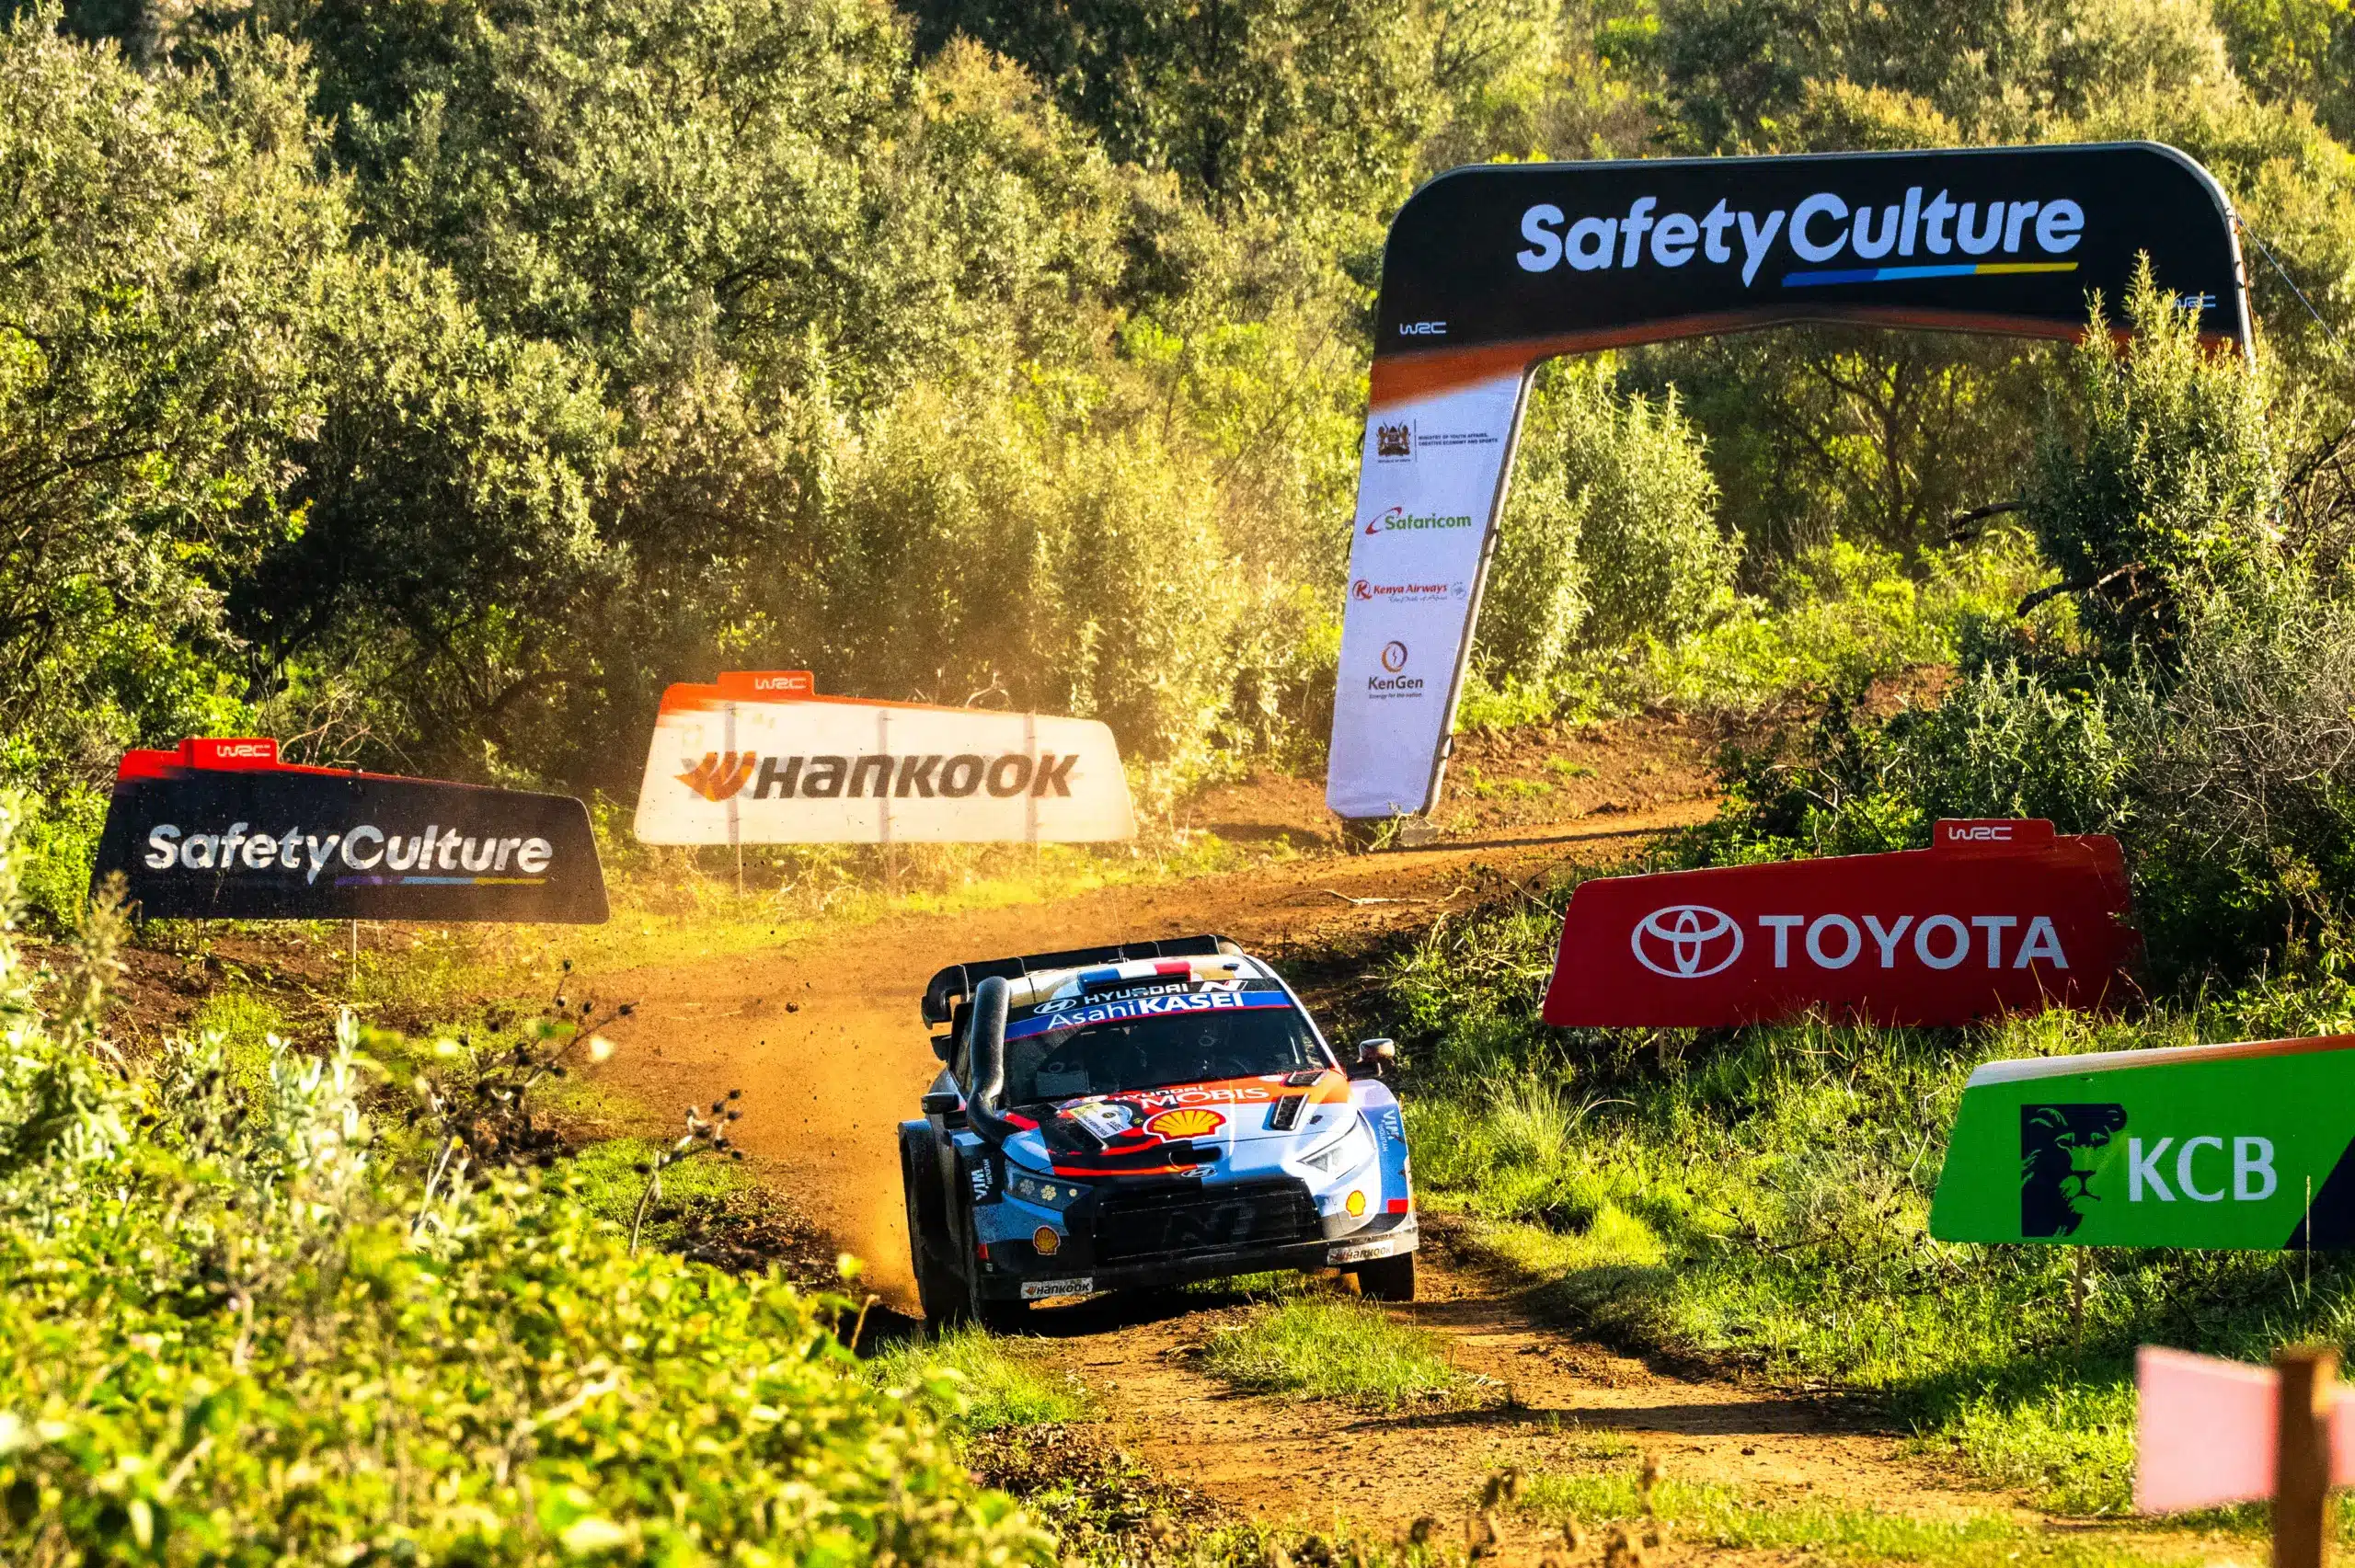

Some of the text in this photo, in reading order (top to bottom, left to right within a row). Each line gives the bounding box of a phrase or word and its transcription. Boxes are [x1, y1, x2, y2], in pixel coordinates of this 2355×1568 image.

[1515, 186, 2085, 288] SafetyCulture
[1399, 321, 1447, 335] WRC
[1384, 513, 1472, 531] Safaricom
[1373, 584, 1404, 596] Kenya
[1406, 583, 1448, 594] Airways
[754, 677, 807, 690] WRC
[1368, 675, 1424, 690] KenGen
[216, 744, 270, 758] WRC
[1948, 827, 2012, 841] WRC
[144, 821, 553, 887] SafetyCulture
[1758, 913, 2069, 970] TOYOTA
[1142, 1086, 1270, 1109] MOBIS
[2127, 1136, 2279, 1203] KCB
